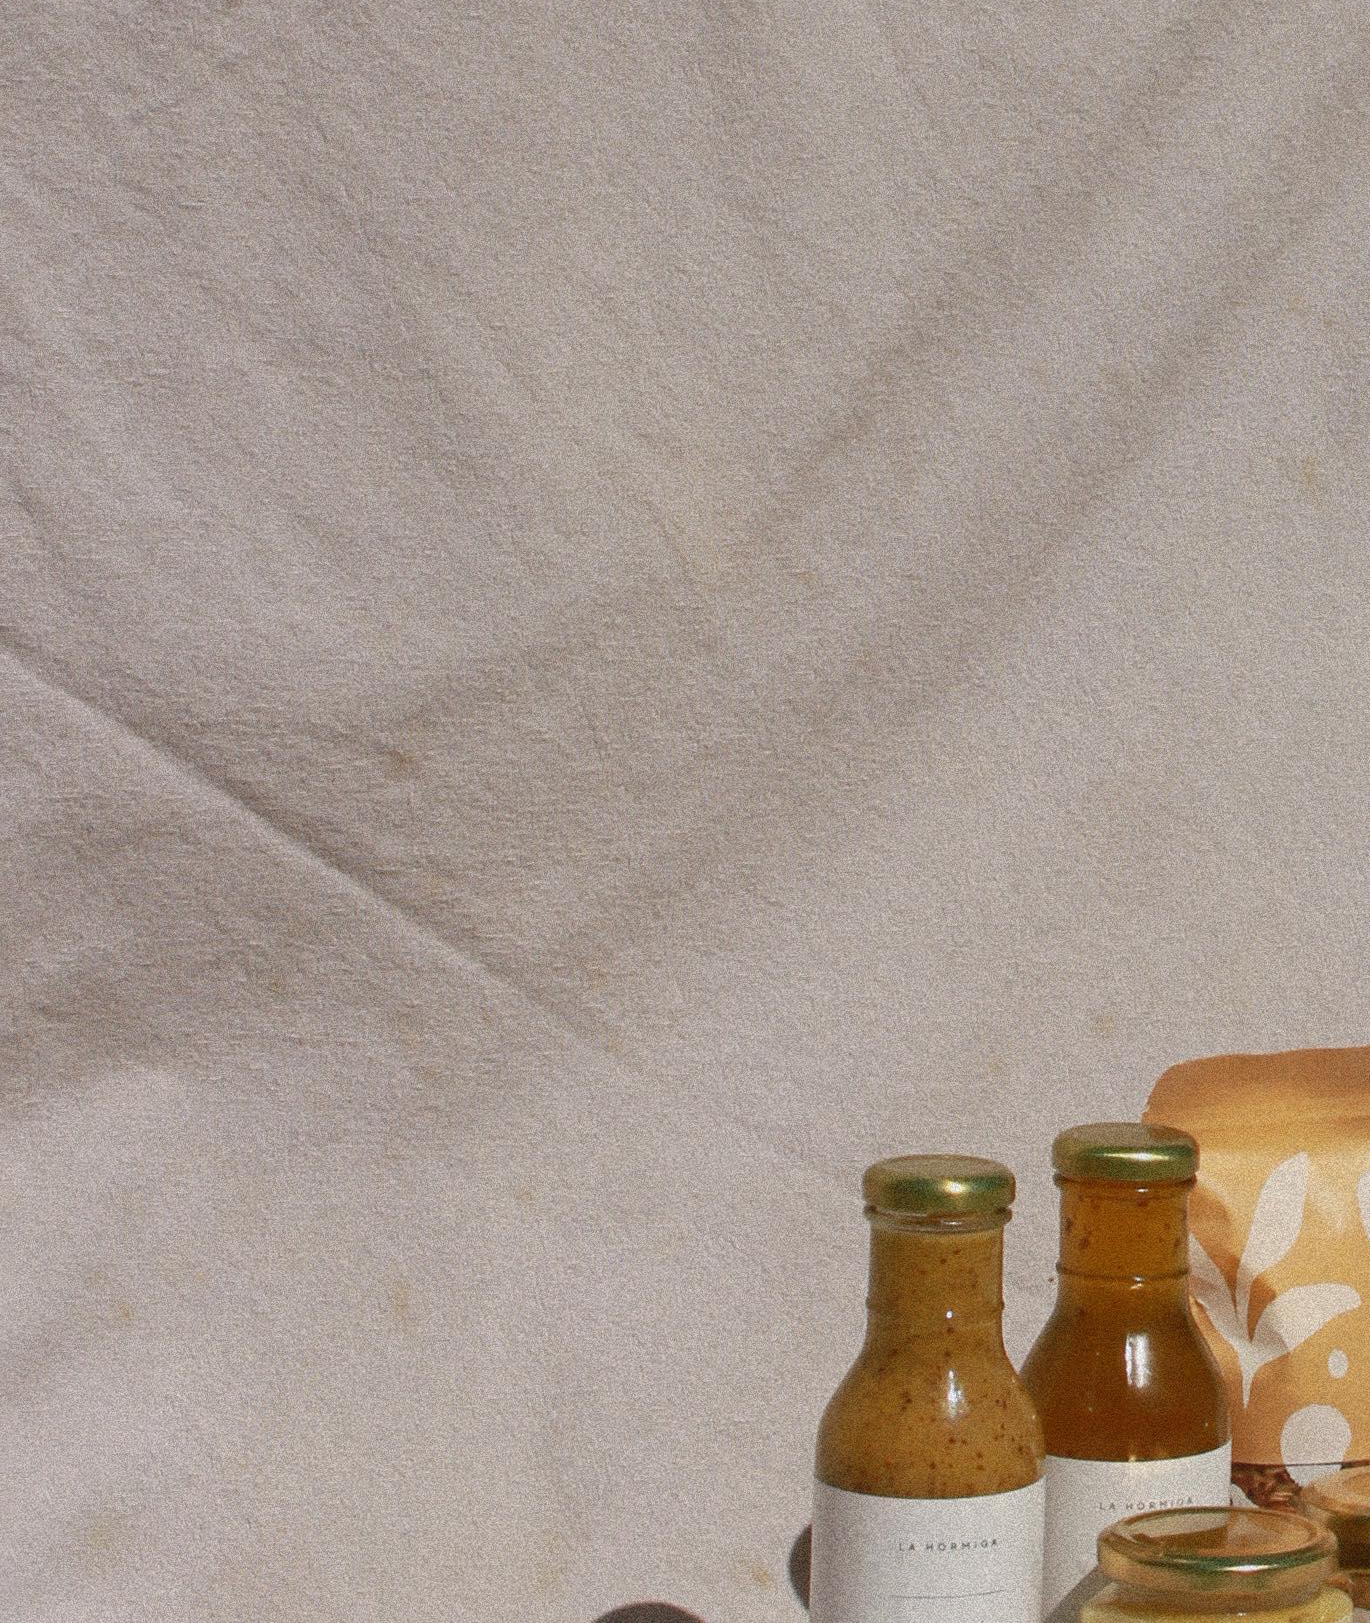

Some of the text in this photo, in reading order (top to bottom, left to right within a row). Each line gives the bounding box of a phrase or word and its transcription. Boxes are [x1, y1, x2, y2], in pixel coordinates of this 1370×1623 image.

[1098, 1497, 1193, 1511] LA HORMIGA
[898, 1537, 998, 1552] LA HORMIGA
